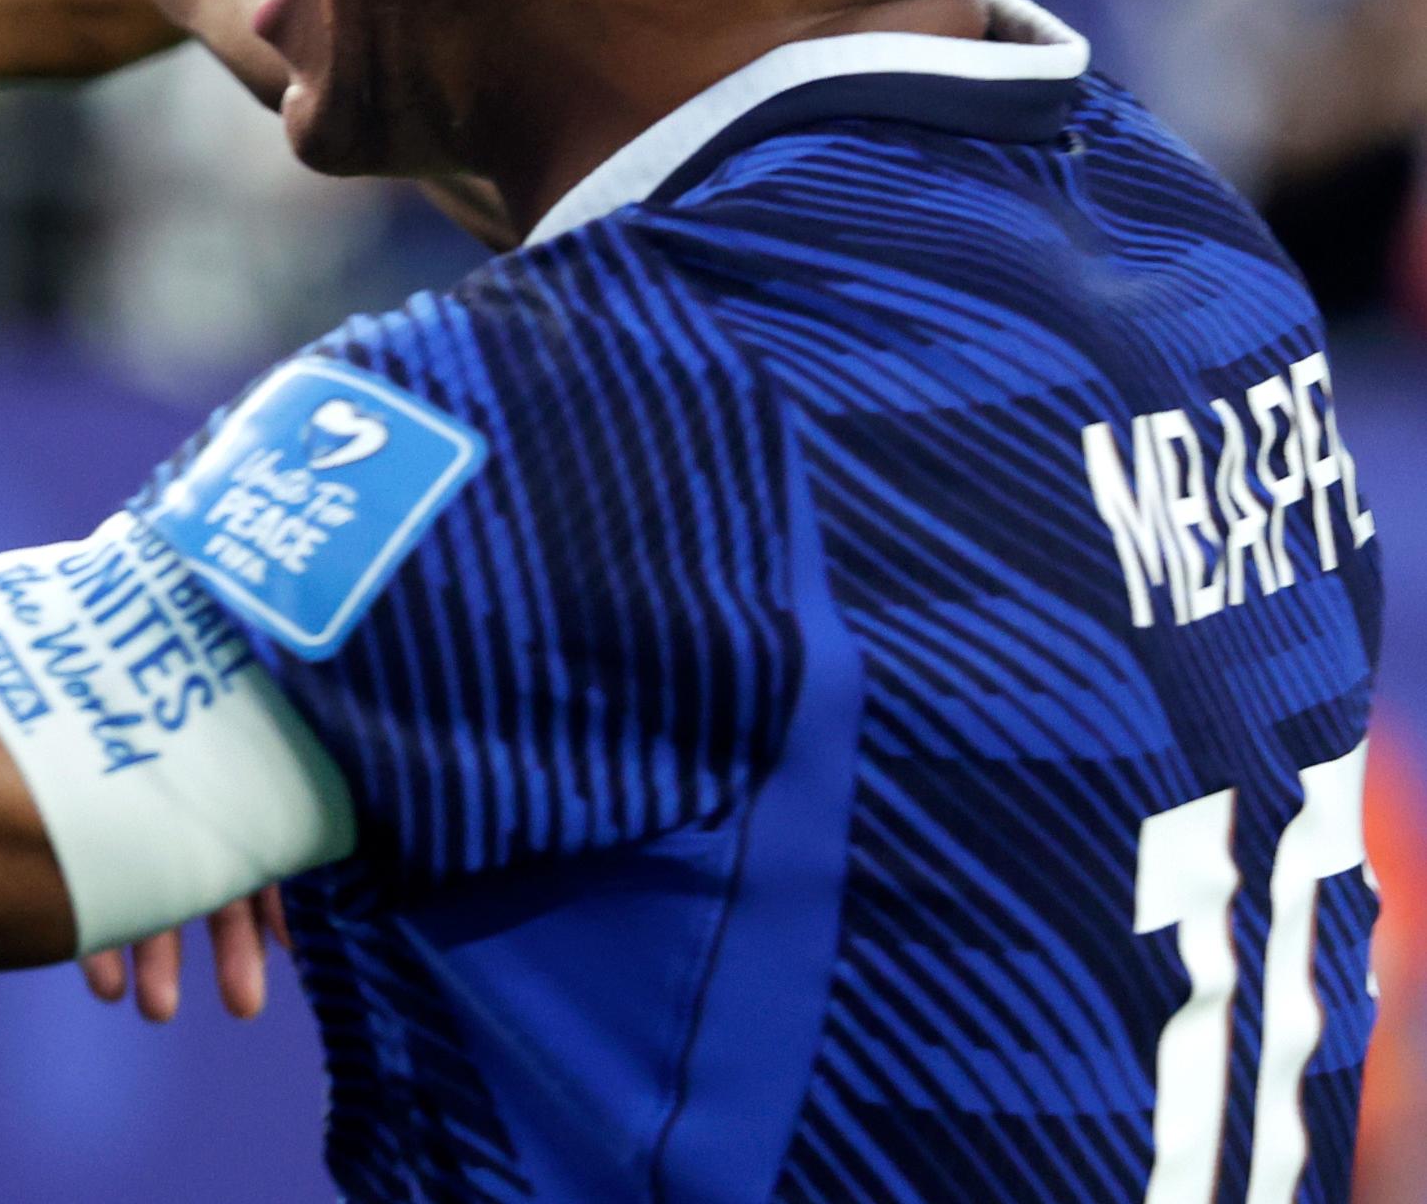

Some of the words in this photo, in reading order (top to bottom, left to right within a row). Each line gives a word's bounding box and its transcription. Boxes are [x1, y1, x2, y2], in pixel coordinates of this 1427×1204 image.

[204, 486, 329, 573] PEACE
[30, 622, 160, 773] World
[56, 541, 215, 731] UNITES
